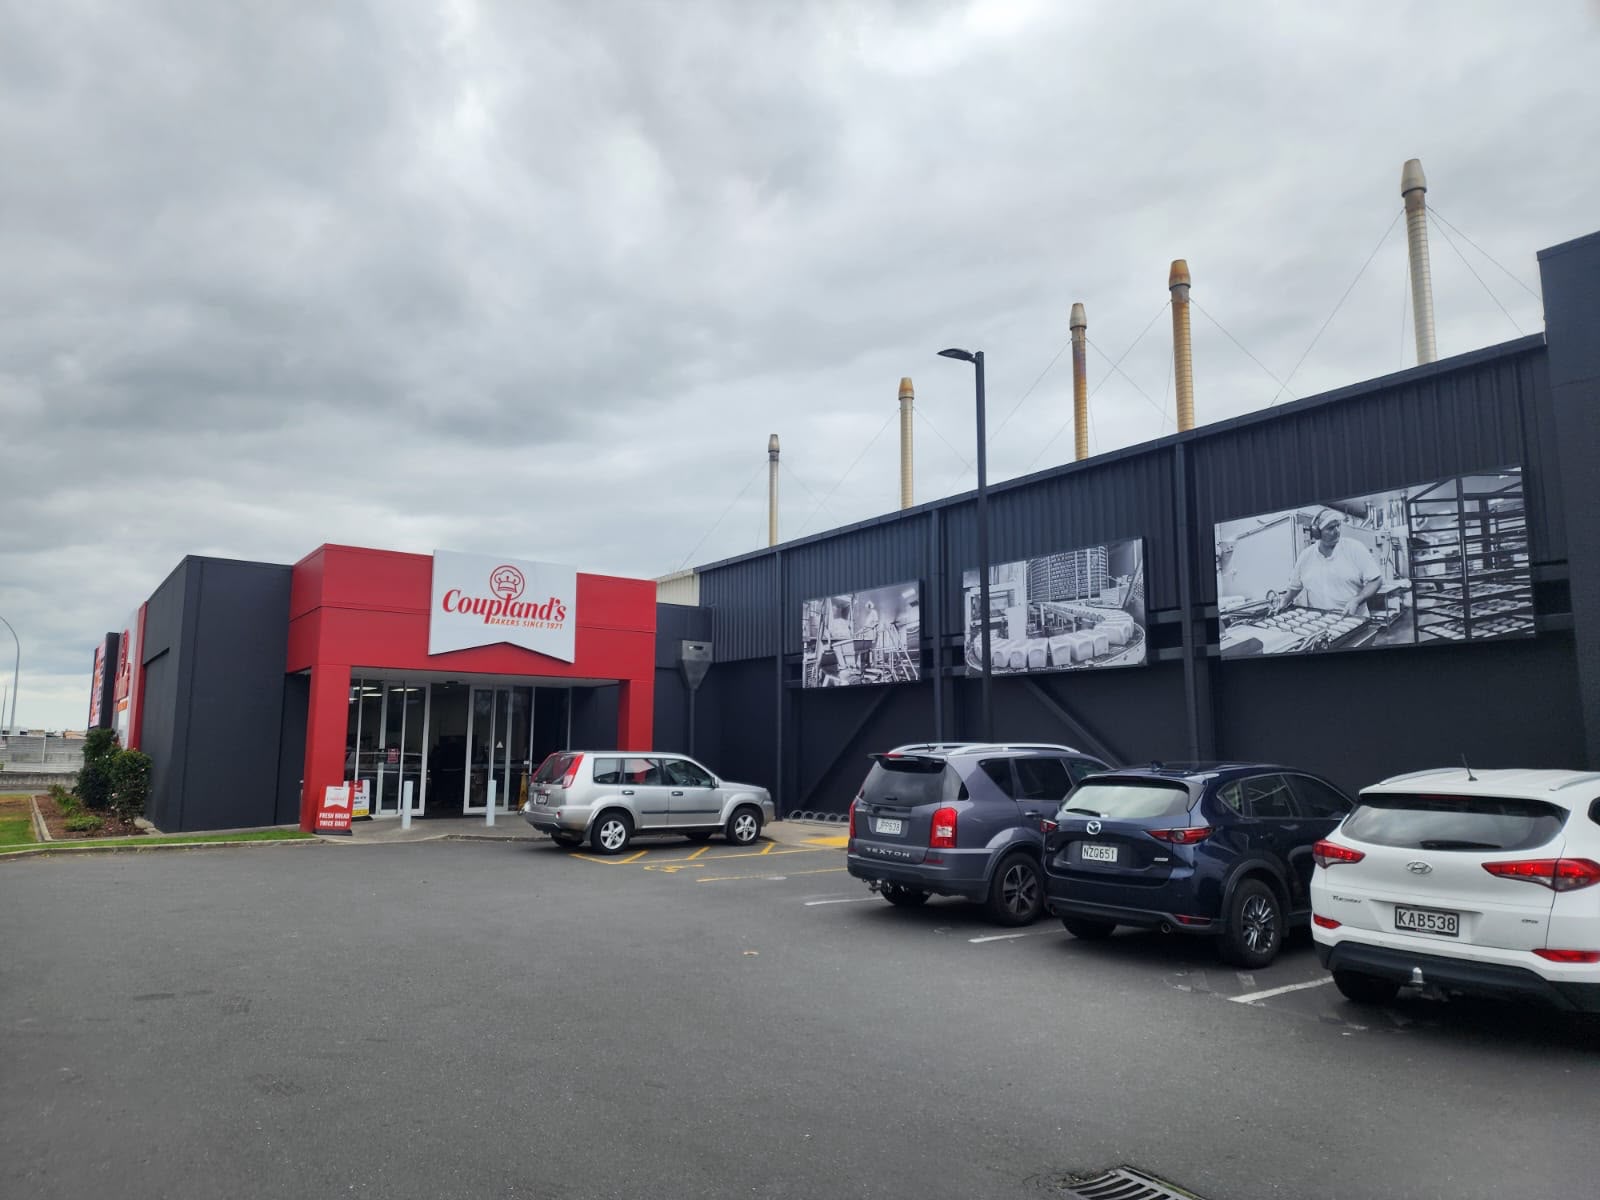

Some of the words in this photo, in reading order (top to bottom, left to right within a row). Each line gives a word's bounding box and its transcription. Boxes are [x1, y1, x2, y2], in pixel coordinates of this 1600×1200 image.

[442, 589, 567, 625] Coupland's
[490, 618, 520, 627] BAKERS
[522, 620, 544, 629] SINCE
[1398, 911, 1456, 931] KAB538
